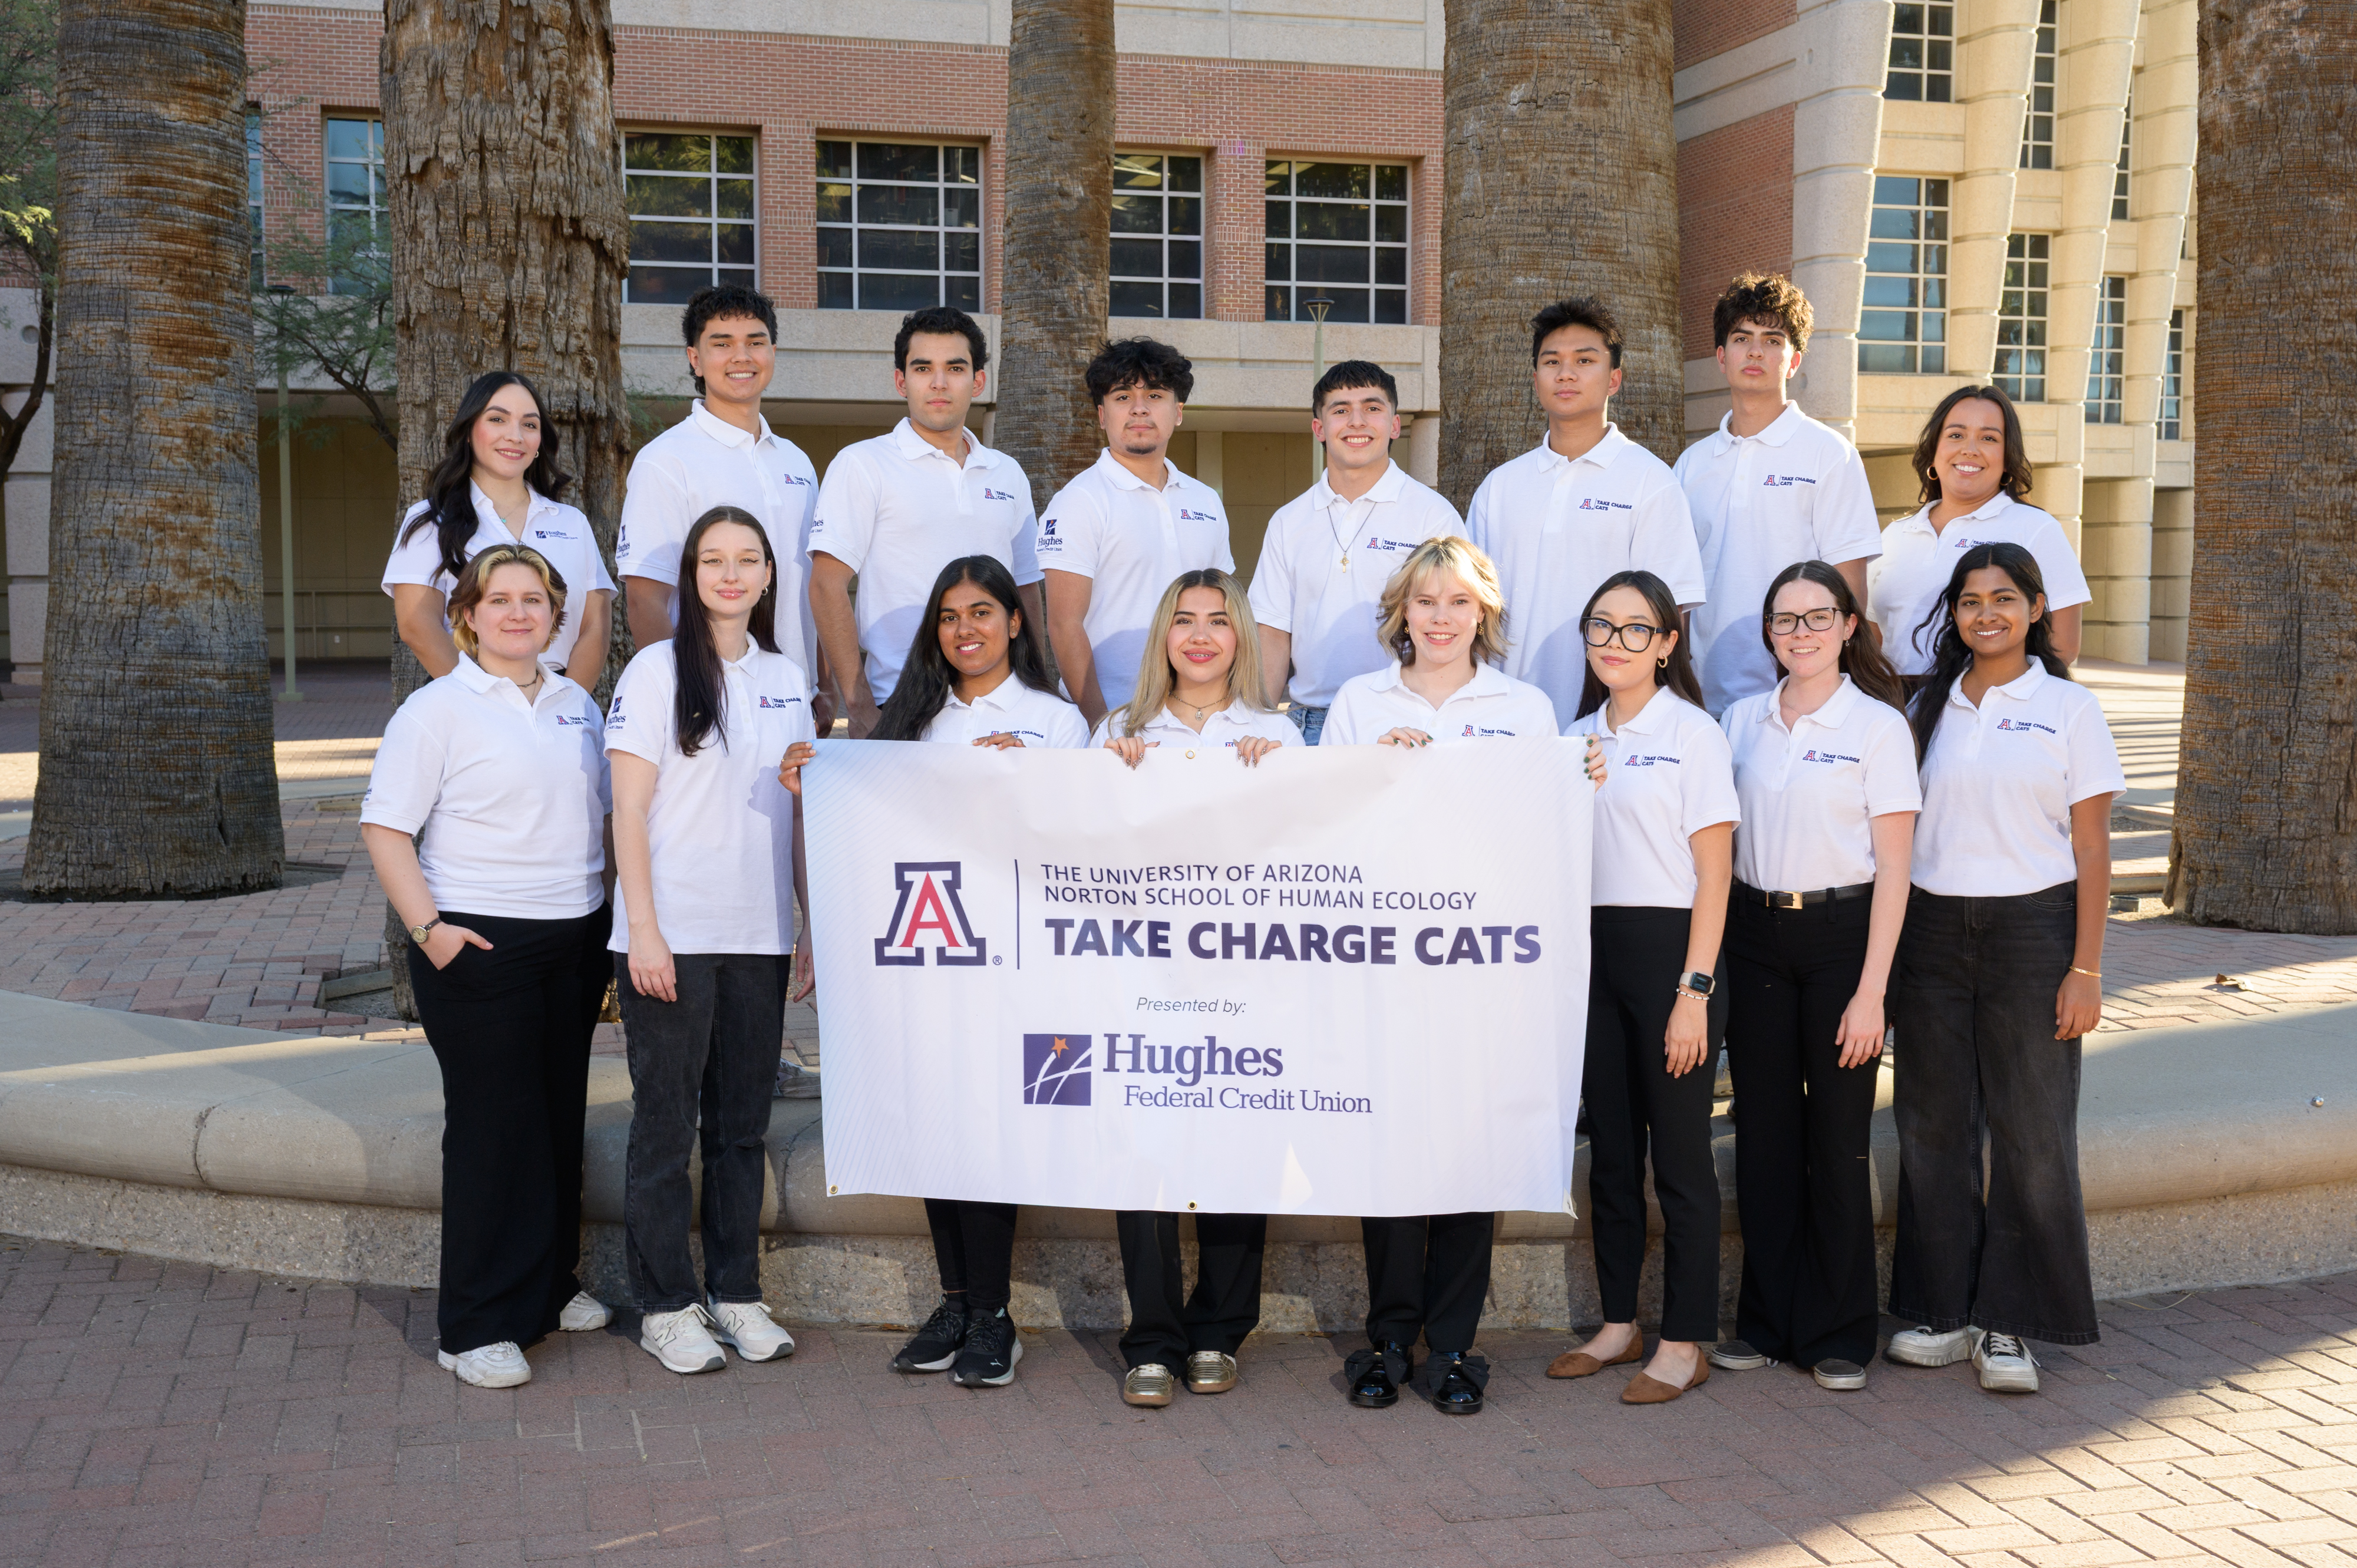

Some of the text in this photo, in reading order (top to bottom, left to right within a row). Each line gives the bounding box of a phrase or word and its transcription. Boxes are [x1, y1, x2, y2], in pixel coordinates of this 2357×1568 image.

[1764, 475, 1776, 486] A
[1579, 499, 1592, 510] A
[1038, 536, 1063, 547] Hughes
[1366, 537, 1378, 549] A
[760, 696, 771, 708] A
[1997, 718, 2011, 730] A
[2033, 723, 2056, 734] CHARGE
[1021, 730, 1044, 738] CHARGE
[1625, 755, 1638, 766] A
[1657, 756, 1681, 764] CHARGE
[1803, 750, 1816, 761] A
[1837, 755, 1860, 764] CHARGE
[1041, 864, 1362, 884] THE UNIVERSITY OF ARIZONA
[1045, 886, 1477, 910] NORTON SCHOOL OF HUMAN ECOLOGY
[874, 861, 986, 966] A
[1045, 919, 1541, 966] TAKE CHARGE CATS
[1136, 997, 1246, 1016] Presented by:
[1103, 1033, 1283, 1087] Hughes
[1124, 1085, 1373, 1113] Federal Credit Union
[721, 1310, 744, 1337] N
[653, 1327, 677, 1351] N
